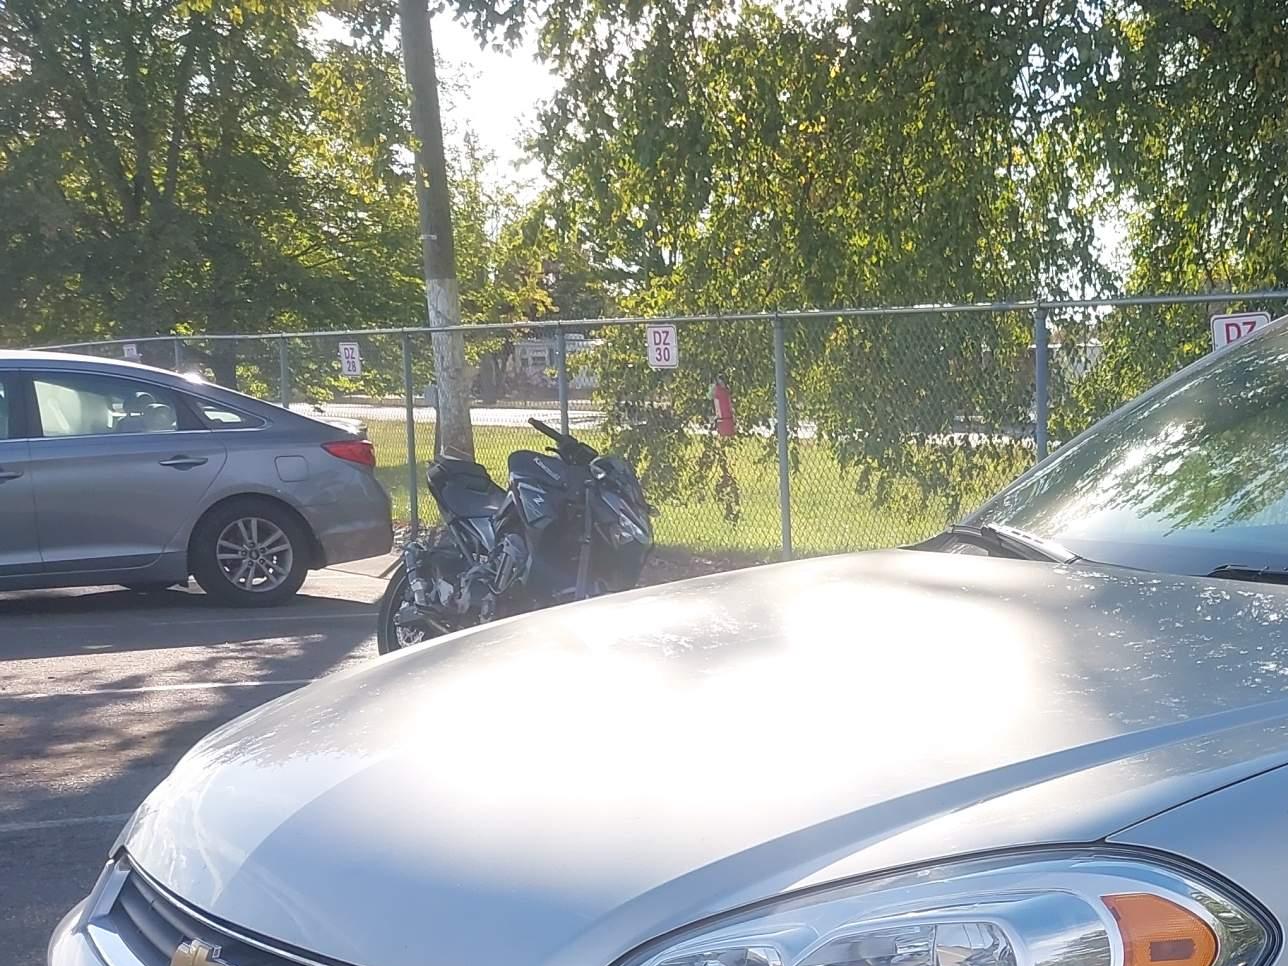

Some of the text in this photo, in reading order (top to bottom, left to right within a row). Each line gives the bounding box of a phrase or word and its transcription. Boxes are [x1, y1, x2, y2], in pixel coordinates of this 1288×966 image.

[653, 330, 671, 346] DZ
[343, 347, 356, 360] DZ
[655, 347, 671, 362] 30
